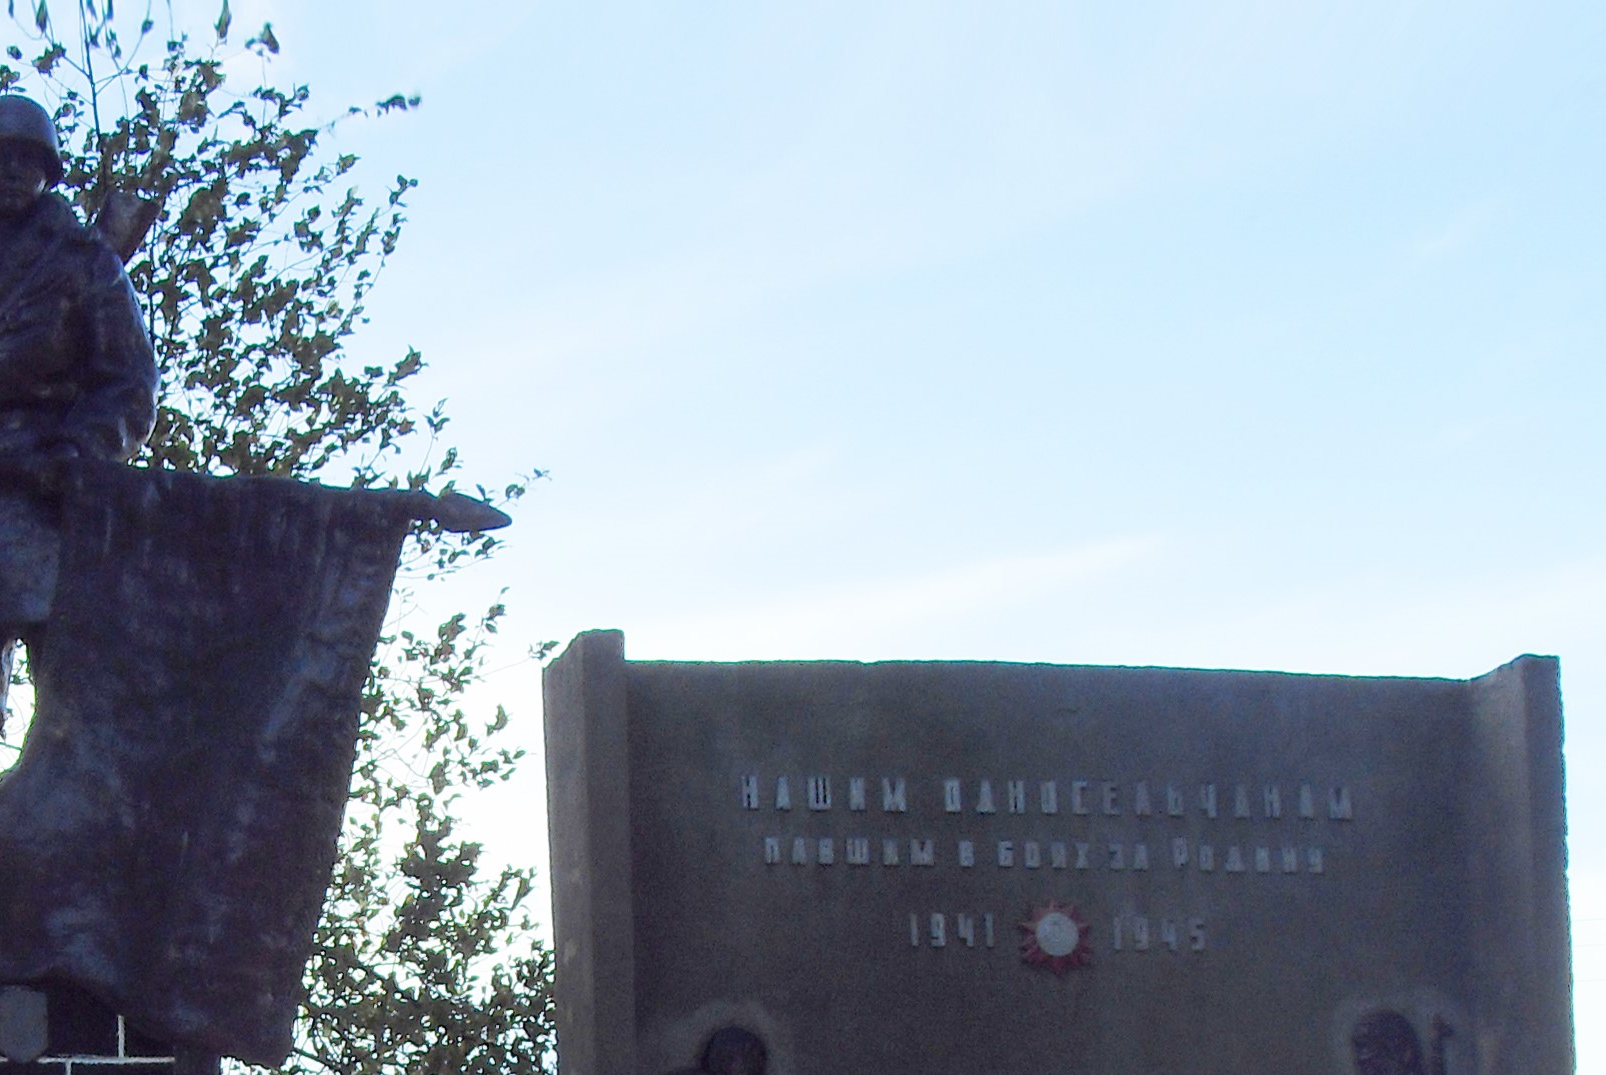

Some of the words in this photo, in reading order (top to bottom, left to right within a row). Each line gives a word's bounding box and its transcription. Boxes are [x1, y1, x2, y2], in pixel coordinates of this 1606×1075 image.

[741, 775, 907, 811] НАШИМ
[764, 836, 935, 865] ПАВШИМ
[958, 840, 975, 867] В
[997, 840, 1090, 869] БОЯХ
[1109, 843, 1149, 870] ЗА
[910, 912, 995, 947] 1941
[1113, 916, 1206, 951] 1945
